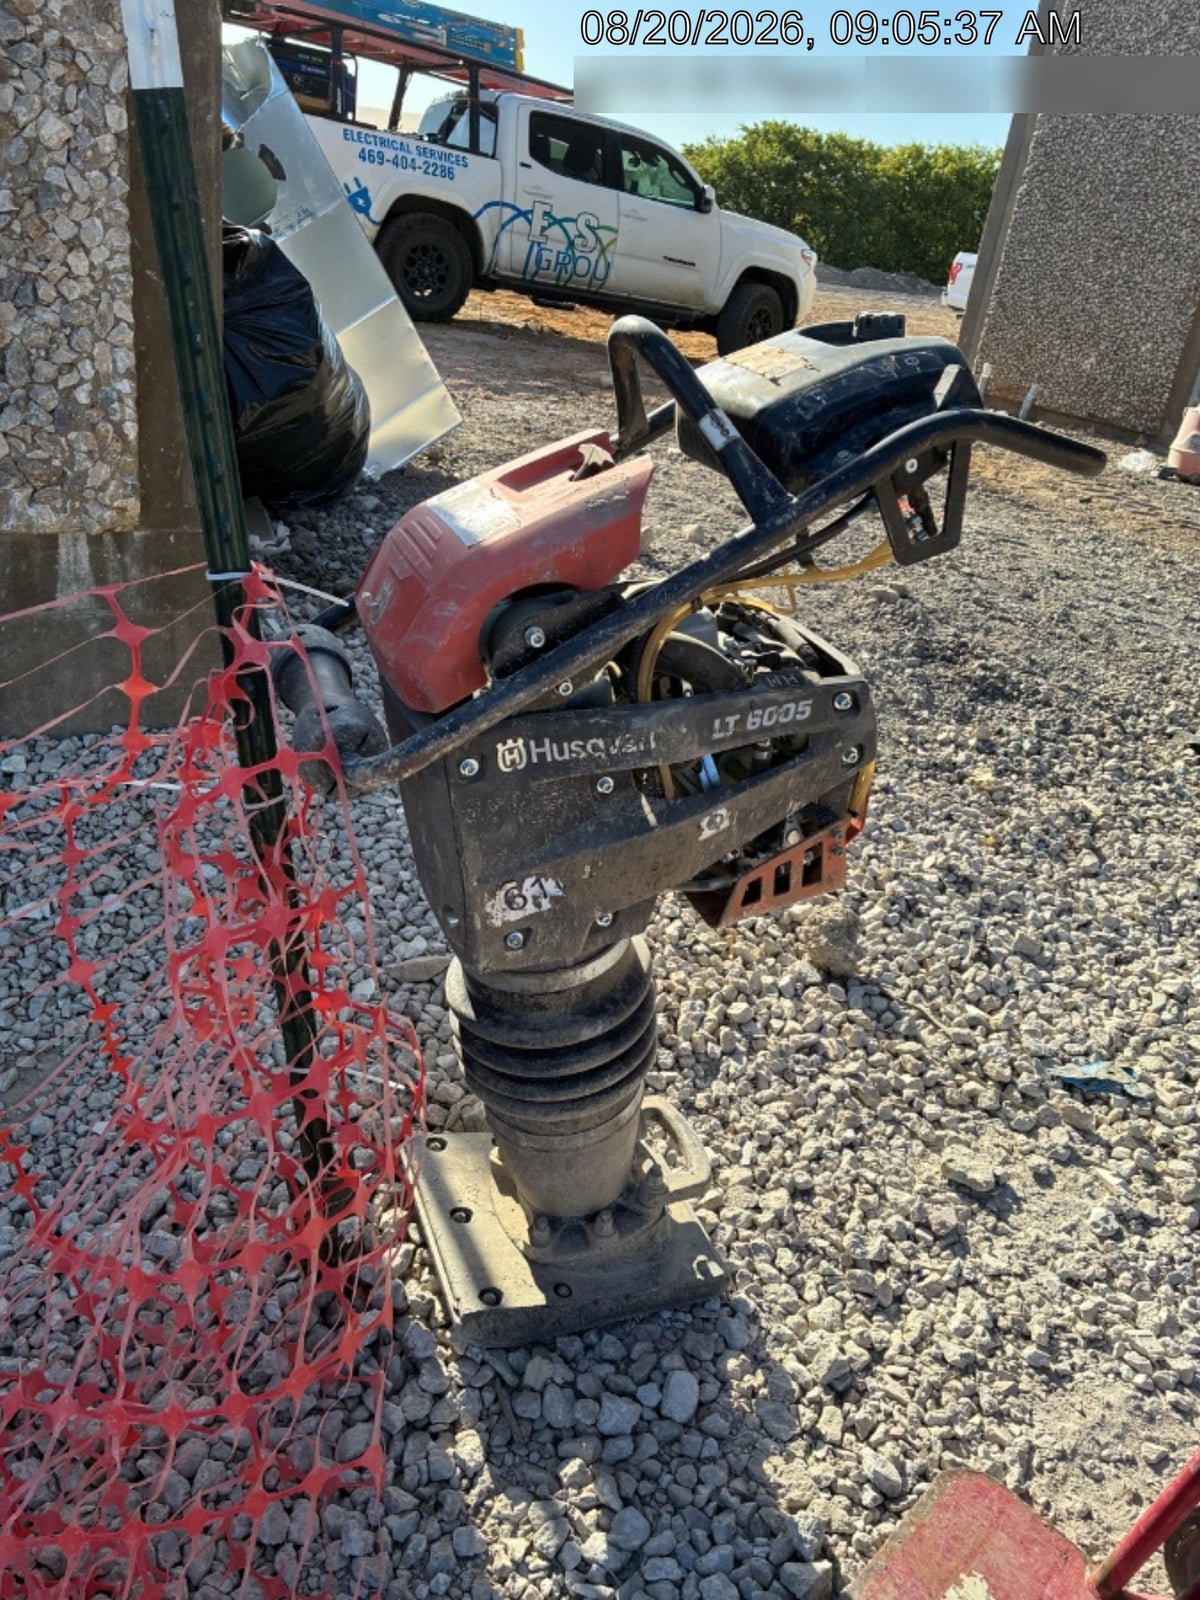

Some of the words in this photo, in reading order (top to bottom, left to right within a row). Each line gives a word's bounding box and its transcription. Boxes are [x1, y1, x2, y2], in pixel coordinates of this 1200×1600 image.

[343, 127, 412, 154] ELECTRICAL
[415, 145, 469, 168] SERVICES
[358, 147, 456, 180] 469-404-2286
[712, 713, 741, 741] LT
[746, 699, 813, 731] 6005
